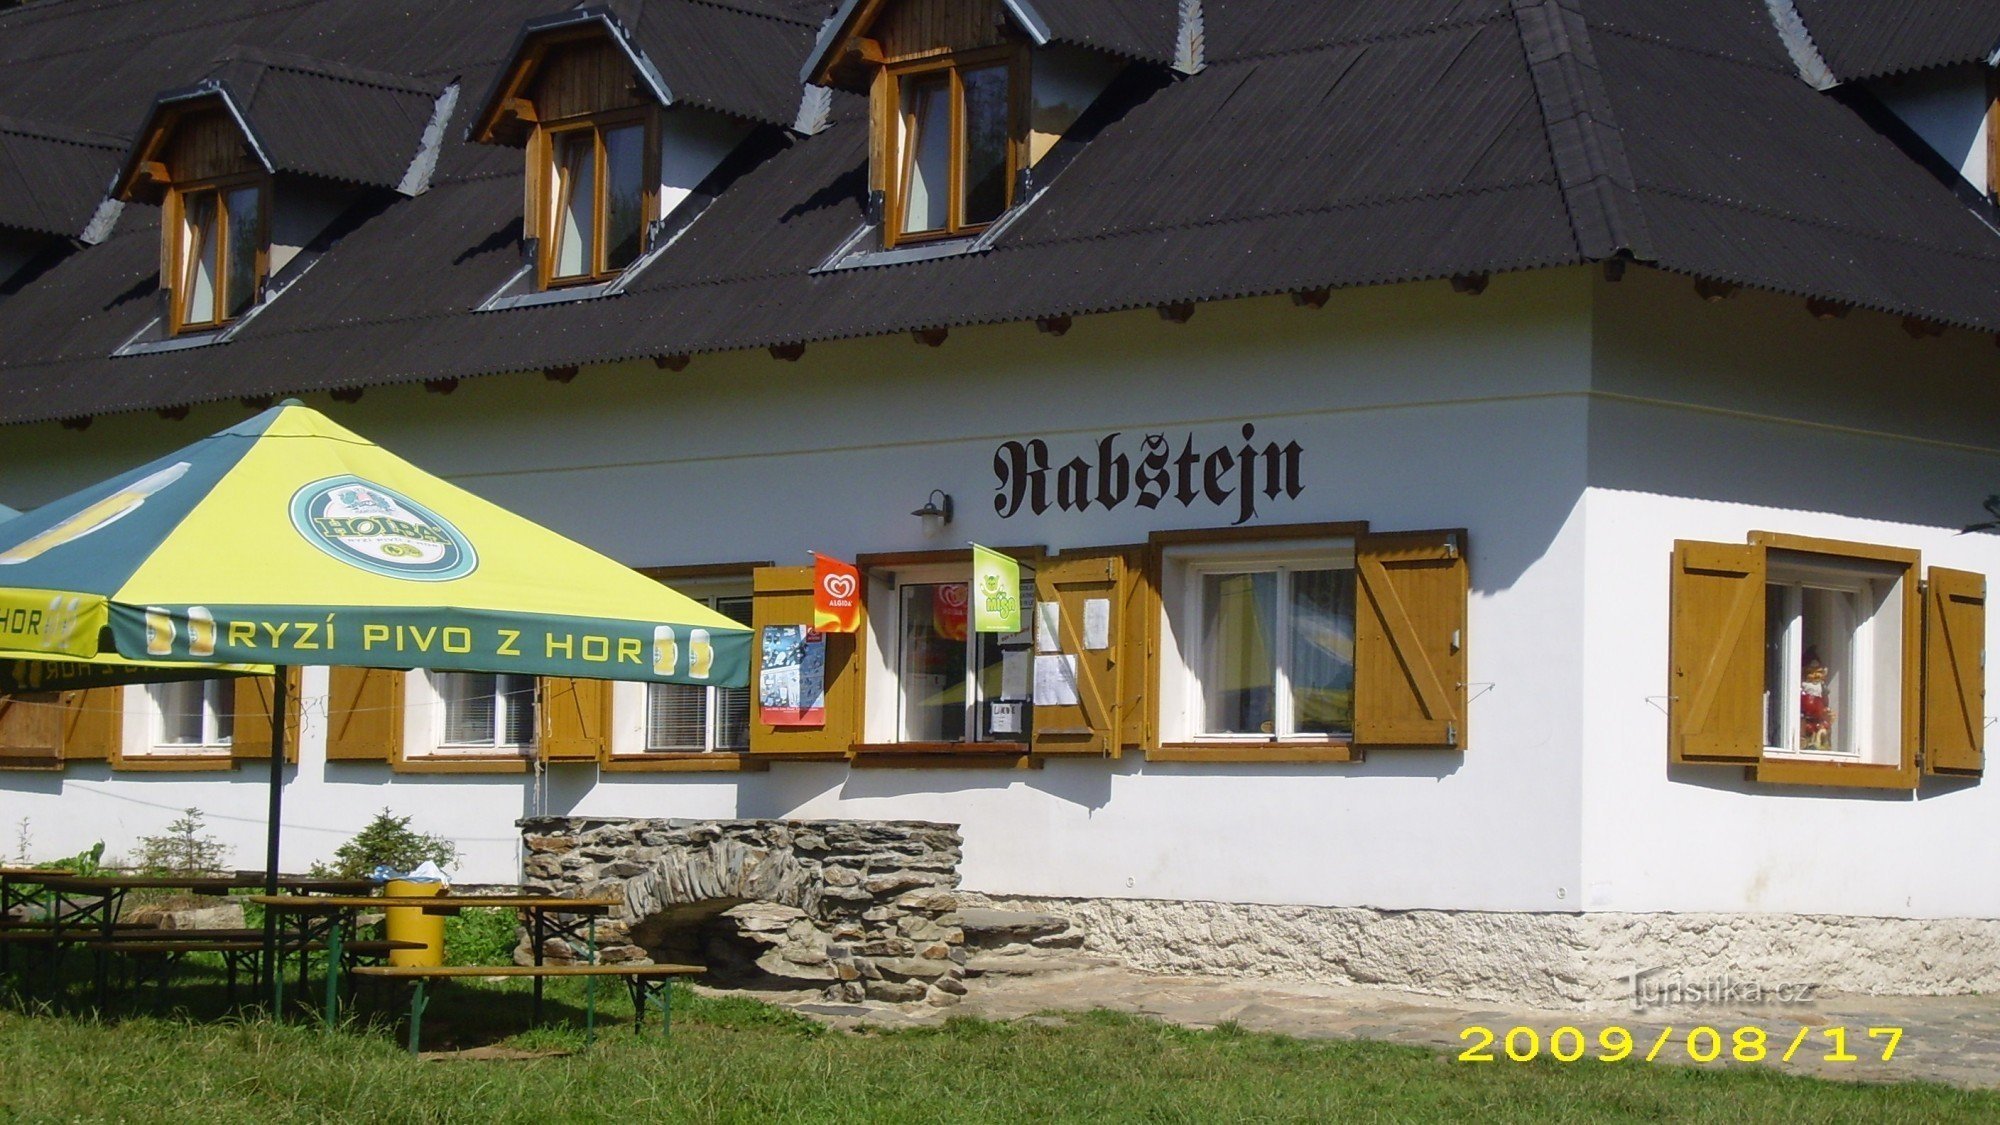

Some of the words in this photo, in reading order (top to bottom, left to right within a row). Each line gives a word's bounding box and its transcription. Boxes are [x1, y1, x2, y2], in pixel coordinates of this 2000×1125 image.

[994, 423, 1306, 525] Rabštejn
[313, 516, 452, 546] HOLBA
[228, 612, 336, 650] RYZÍ
[363, 624, 472, 654] PIVO
[495, 629, 522, 657] Z
[545, 632, 644, 665] HOR
